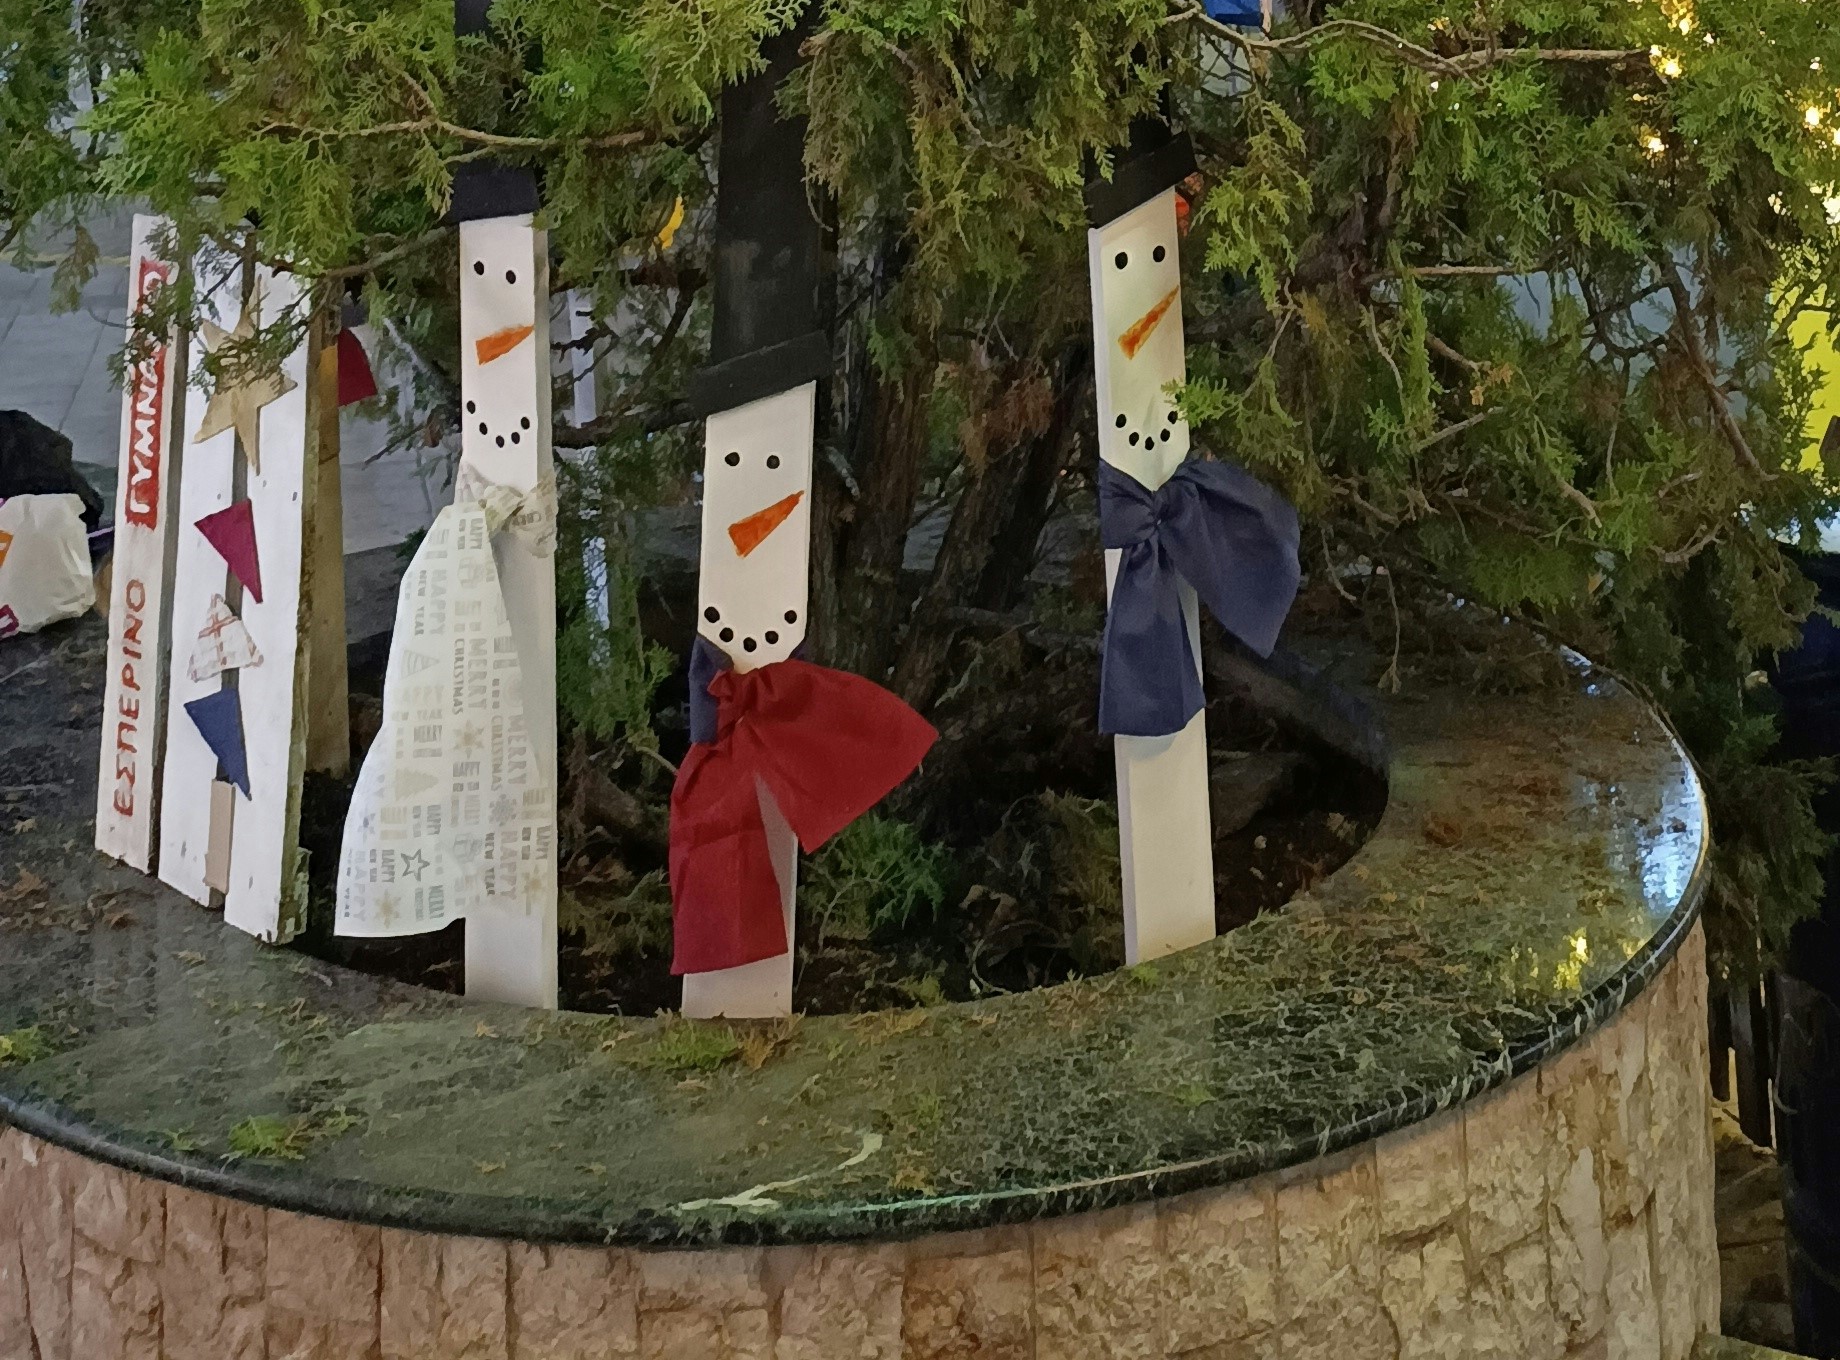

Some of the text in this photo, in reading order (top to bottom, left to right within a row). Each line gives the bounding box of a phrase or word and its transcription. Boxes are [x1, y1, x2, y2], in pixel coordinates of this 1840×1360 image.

[113, 579, 146, 816] ΕΣΠΕΡΙΝΟ
[452, 638, 465, 715] CHRISTMAS
[468, 638, 487, 709] MERRY
